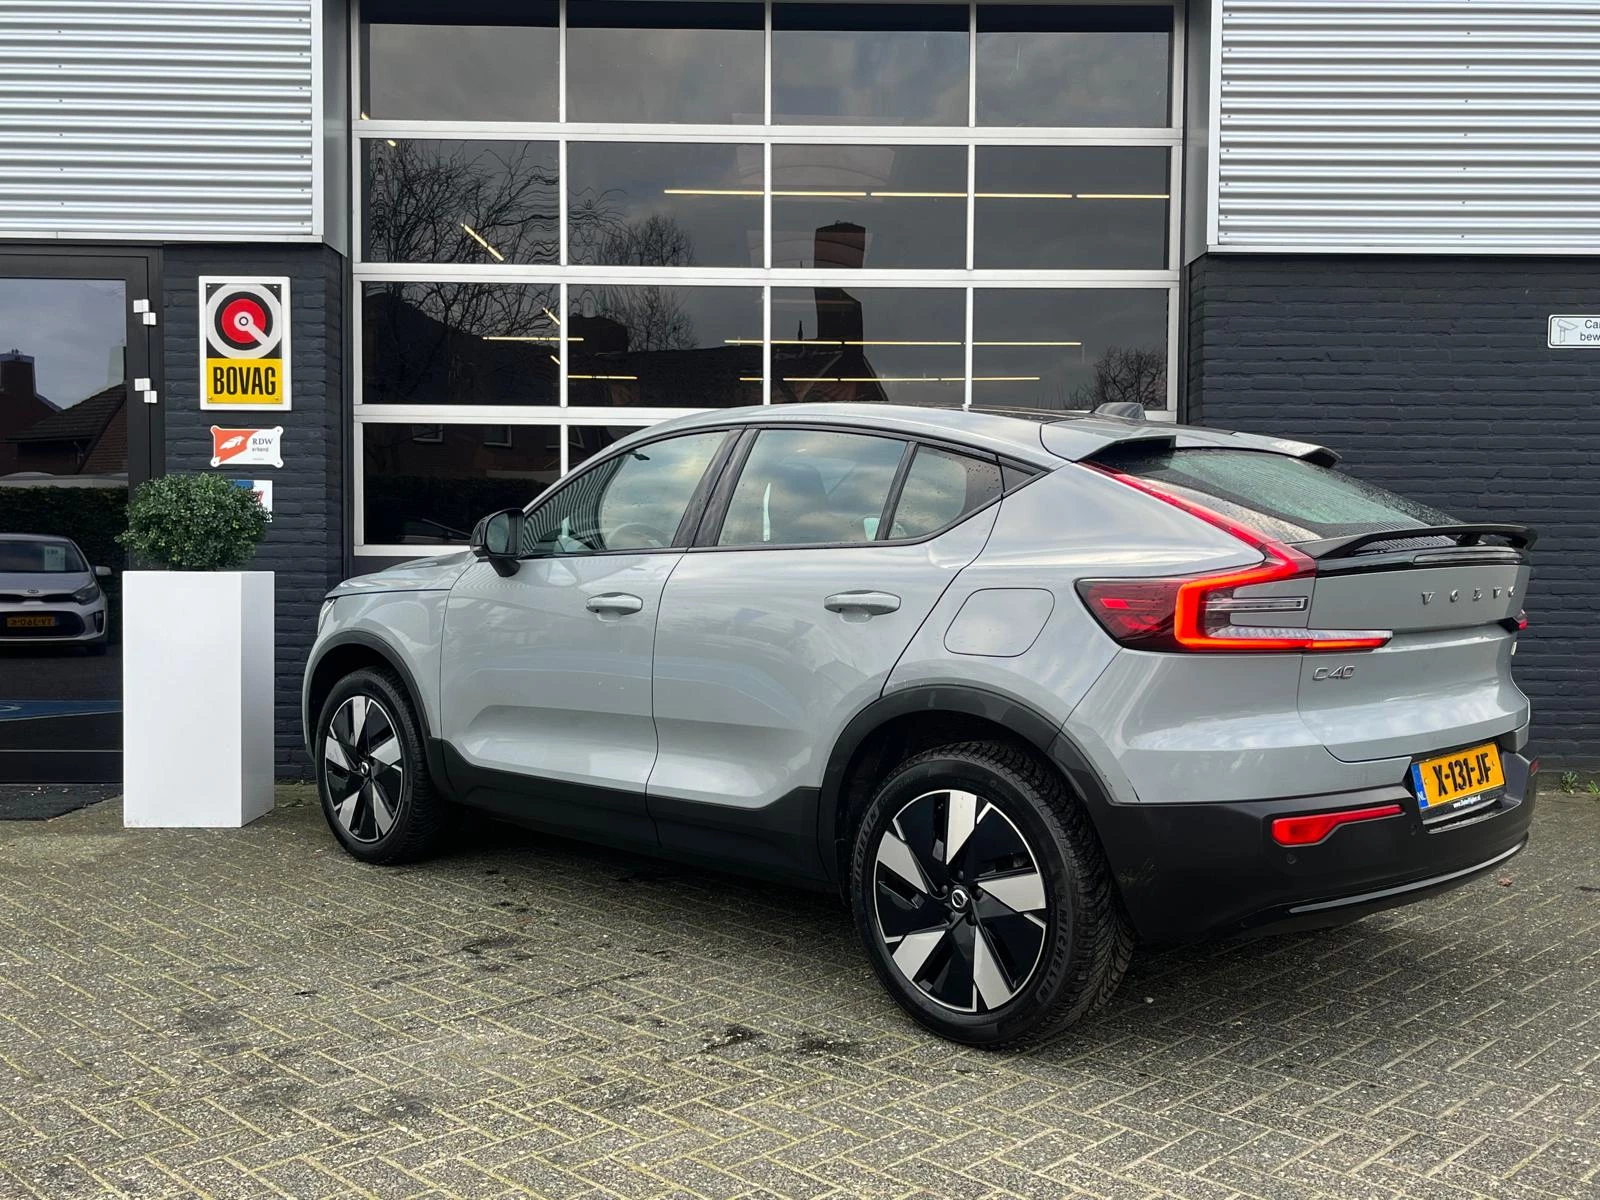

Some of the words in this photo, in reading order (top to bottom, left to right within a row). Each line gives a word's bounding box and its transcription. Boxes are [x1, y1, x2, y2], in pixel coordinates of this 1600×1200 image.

[1585, 319, 1600, 329] Ca
[213, 366, 276, 396] BOVAG
[252, 437, 274, 445] RDW
[1421, 586, 1515, 606] VOLVO
[1312, 665, 1356, 681] C40
[1432, 752, 1492, 796] X-131-JF
[1416, 790, 1427, 801] NL
[853, 806, 880, 894] MICHELIN
[1039, 908, 1068, 998] MICHELIN
